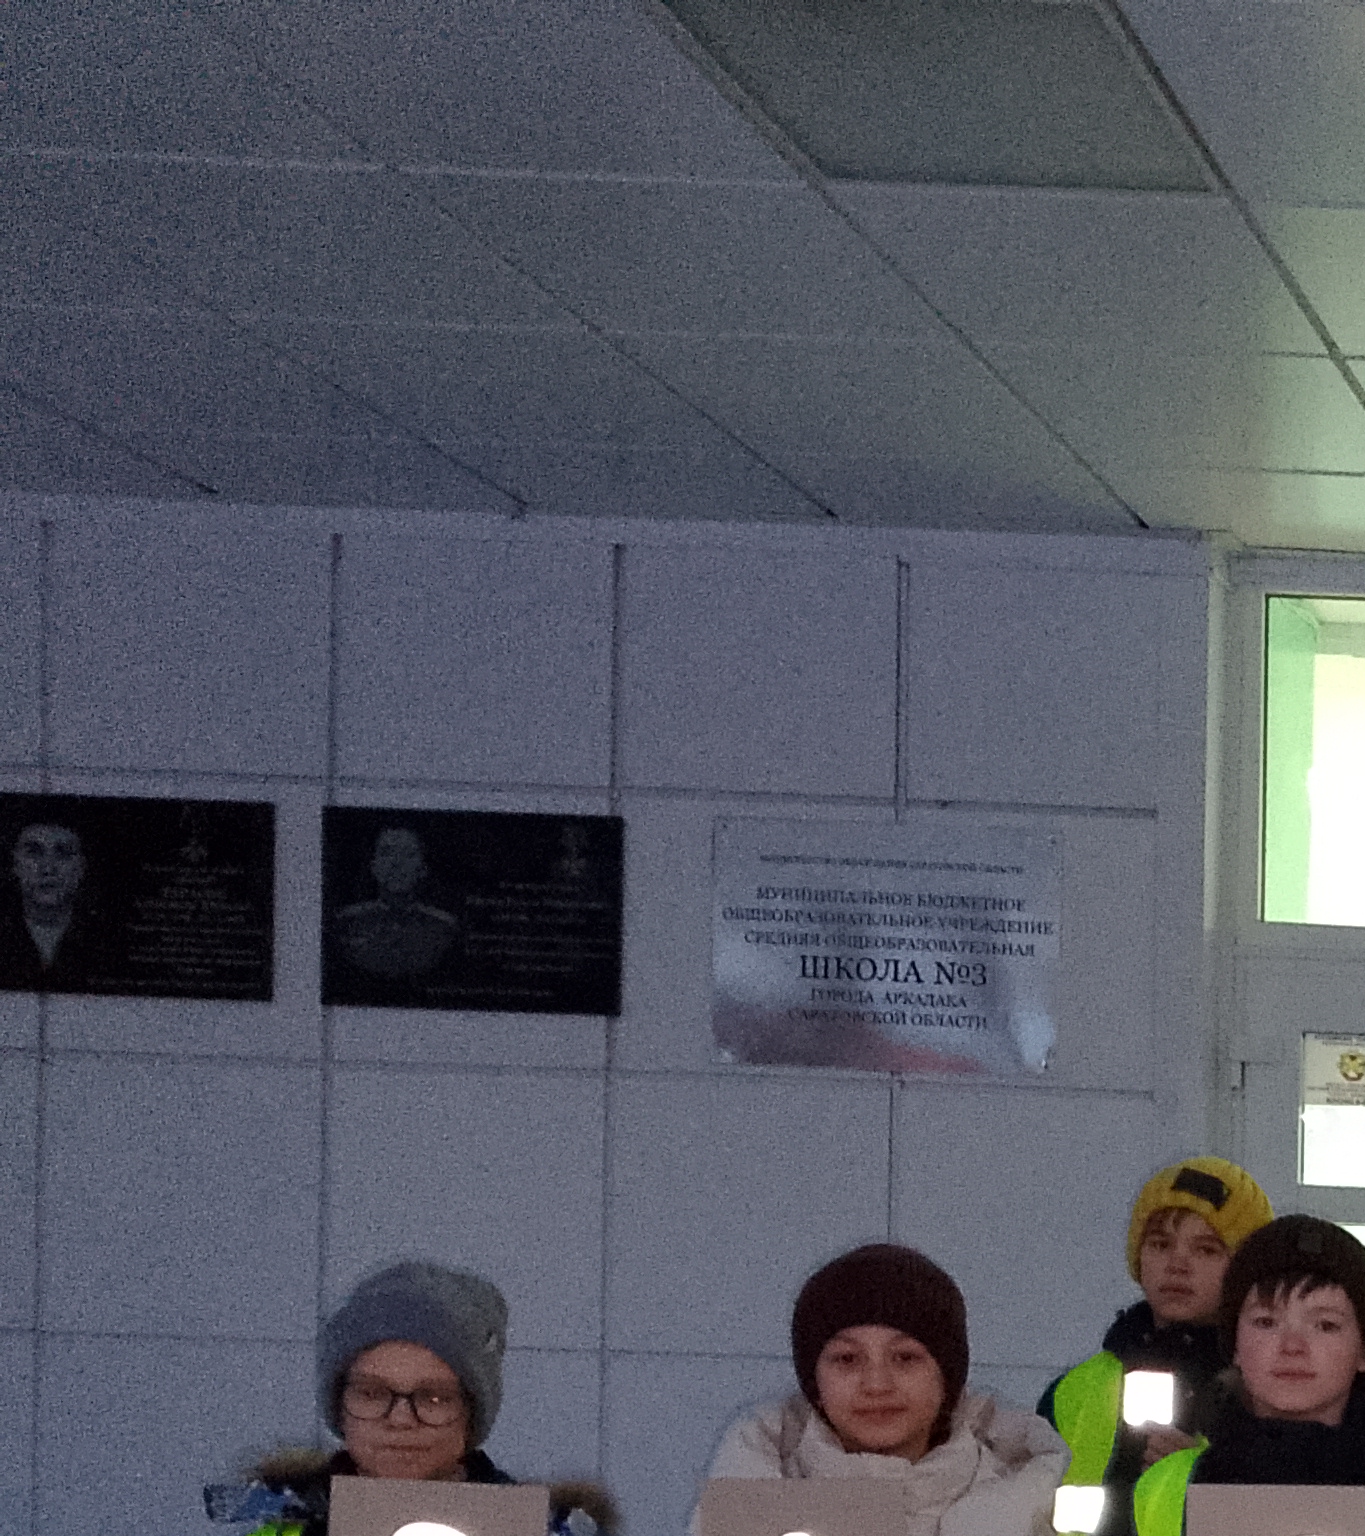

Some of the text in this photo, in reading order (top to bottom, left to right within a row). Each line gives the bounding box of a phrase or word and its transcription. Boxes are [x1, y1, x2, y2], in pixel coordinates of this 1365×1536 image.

[799, 954, 988, 987] ШКОЛА №3
[910, 1012, 989, 1031] ОБЛАСТИ
